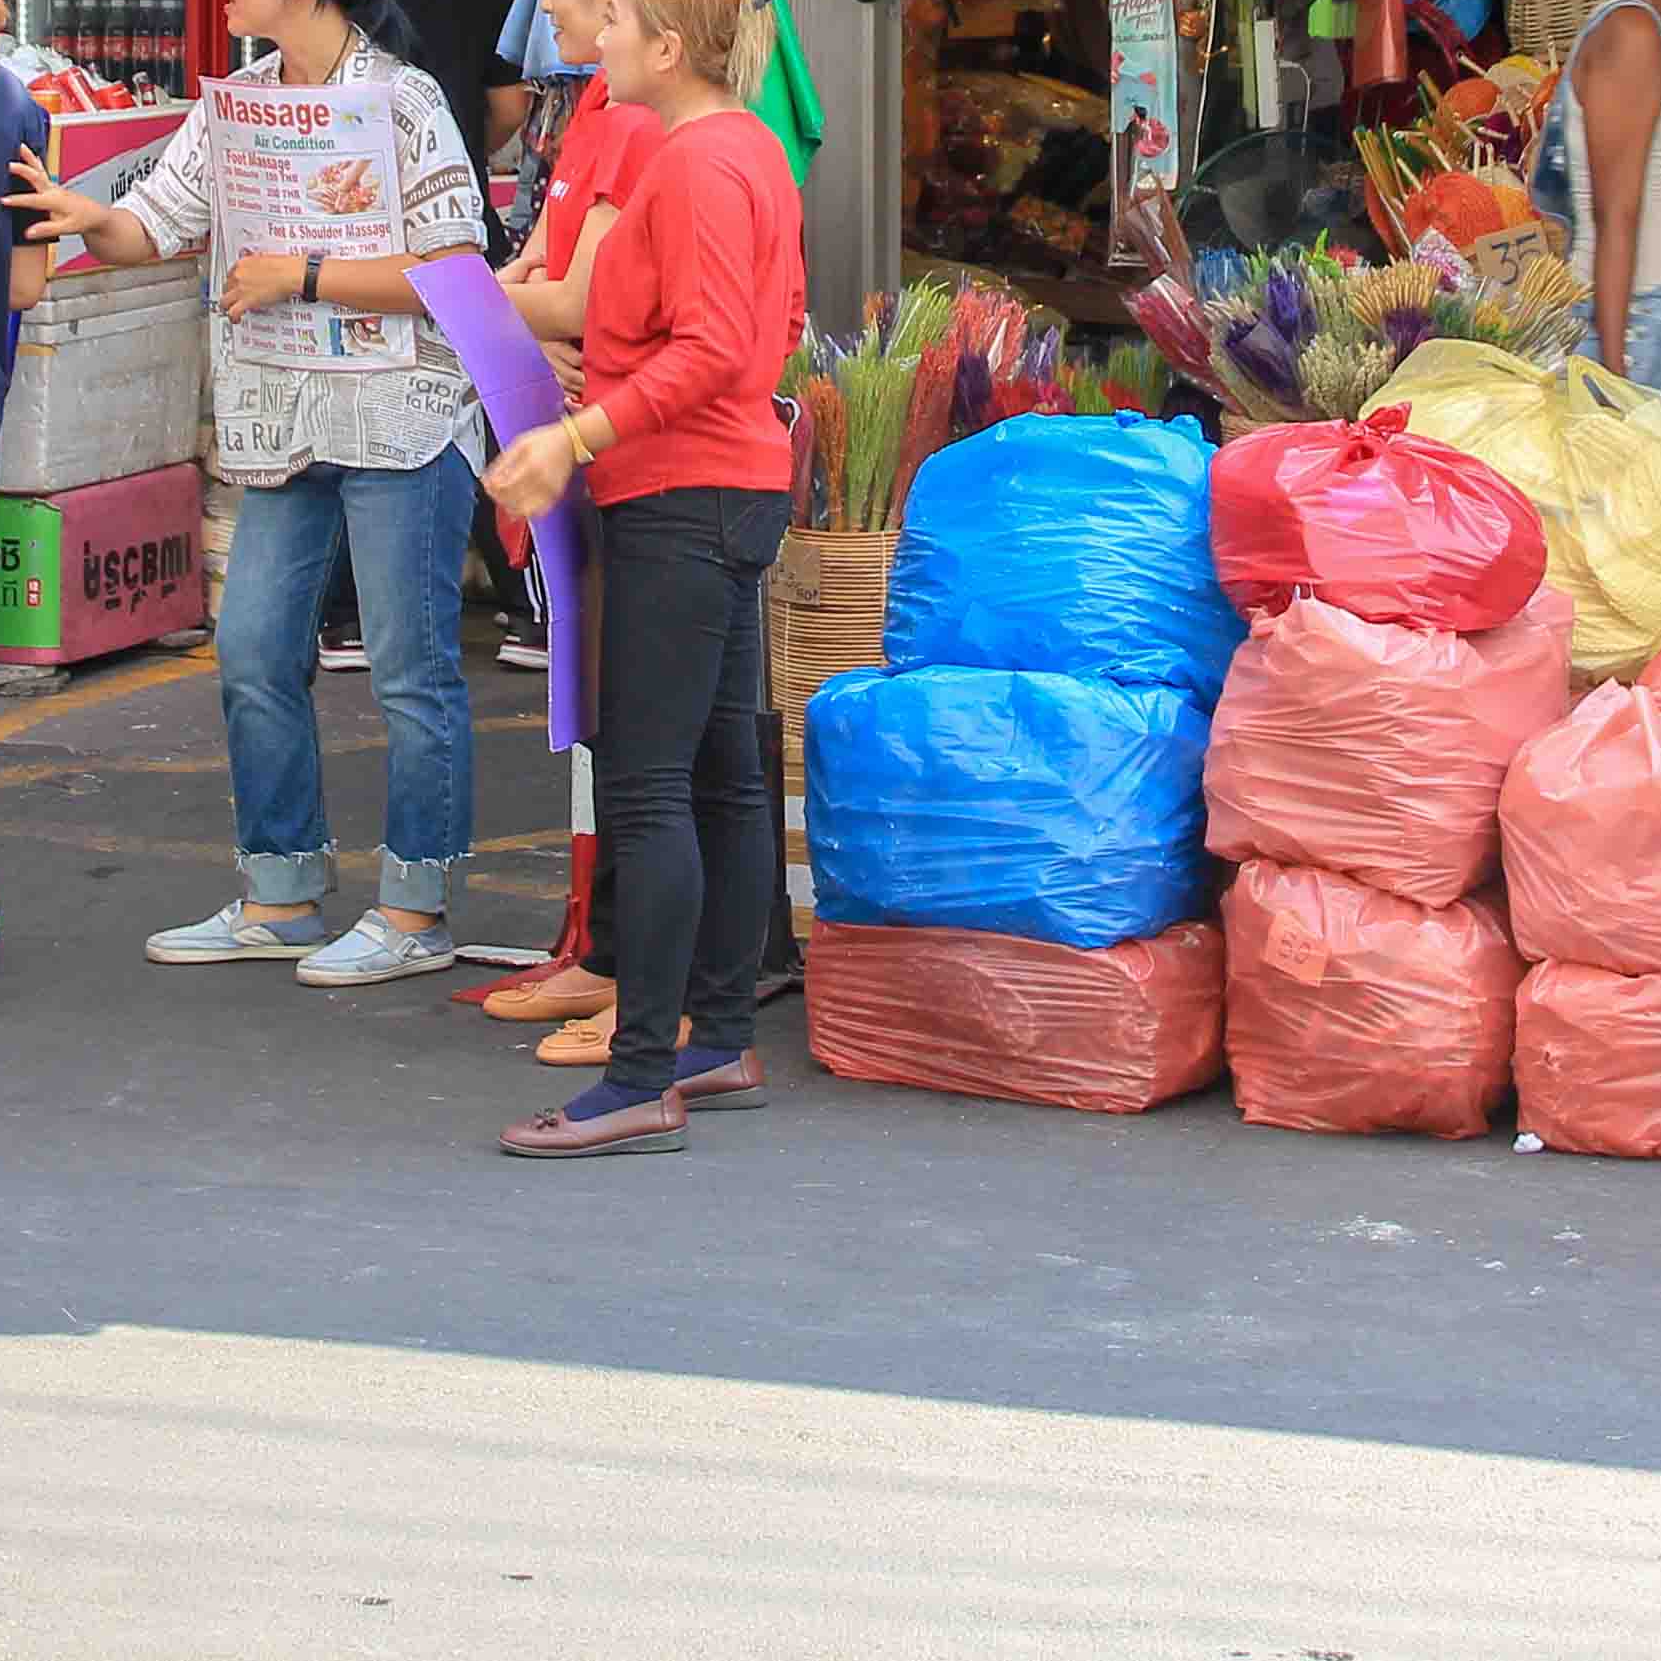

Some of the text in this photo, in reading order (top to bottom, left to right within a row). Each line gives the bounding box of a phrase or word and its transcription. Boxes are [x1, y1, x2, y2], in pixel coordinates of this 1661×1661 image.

[213, 91, 331, 136] Massage
[254, 135, 335, 151] Air Condition
[226, 149, 291, 171] Foot Massage
[289, 224, 298, 238] &
[299, 224, 342, 239] Shoulder
[344, 221, 391, 238] Massage
